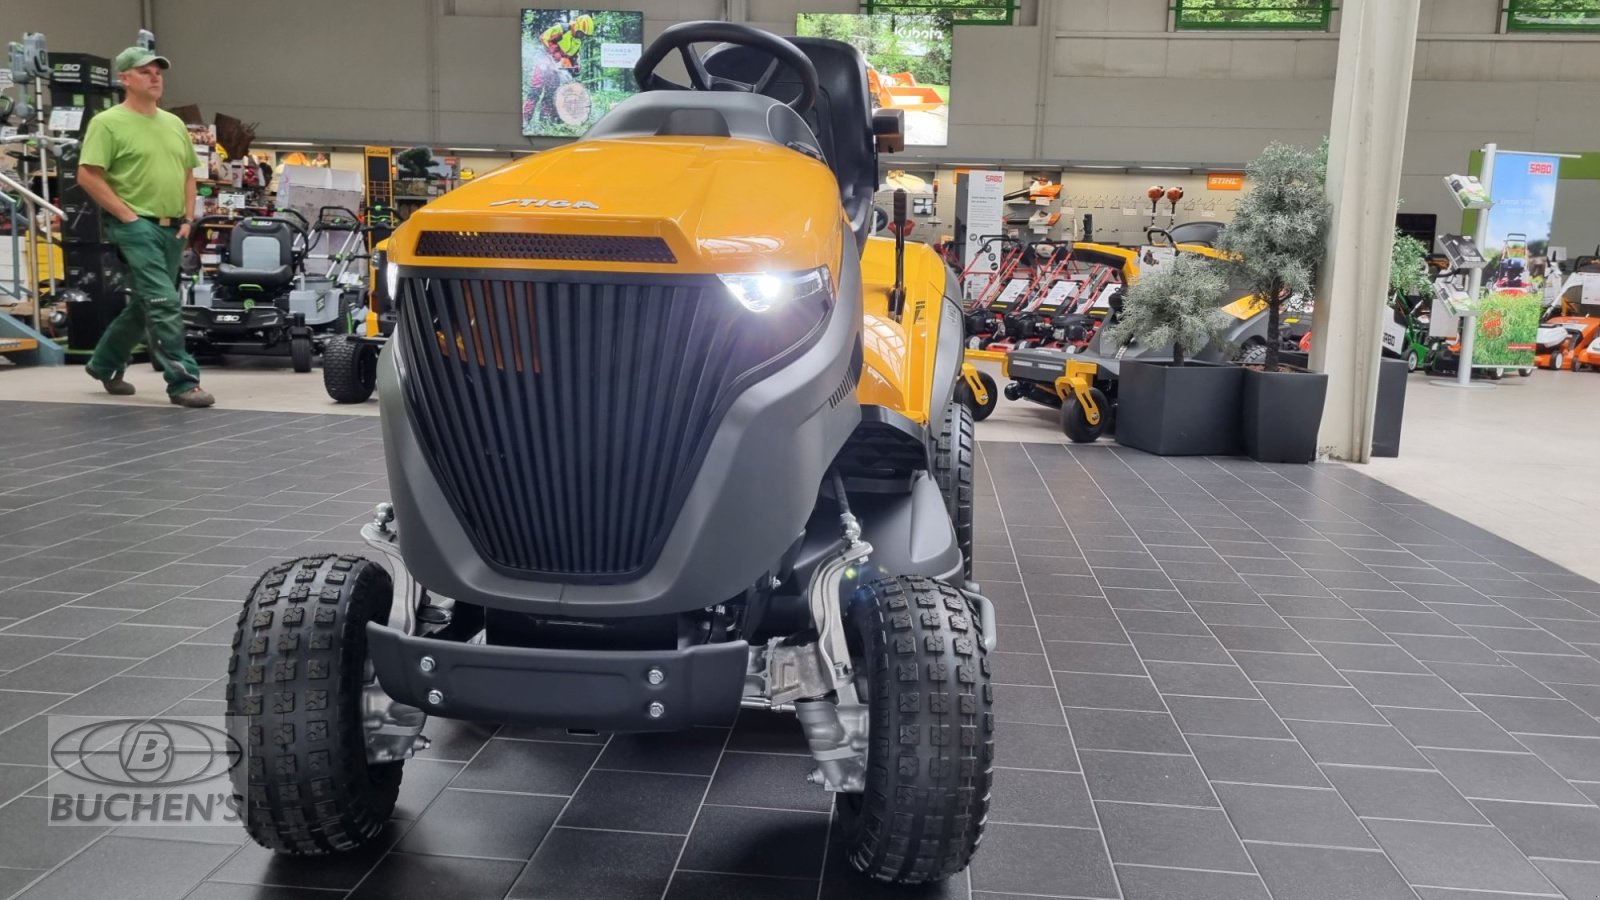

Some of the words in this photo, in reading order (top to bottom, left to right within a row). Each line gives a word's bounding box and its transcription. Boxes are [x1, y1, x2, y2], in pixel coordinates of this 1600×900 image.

[895, 26, 944, 40] Kubota
[54, 63, 81, 72] EGO
[1530, 163, 1552, 174] SABO
[985, 174, 1003, 183] SABO
[1211, 177, 1238, 185] STIHL
[489, 198, 600, 210] STIGA
